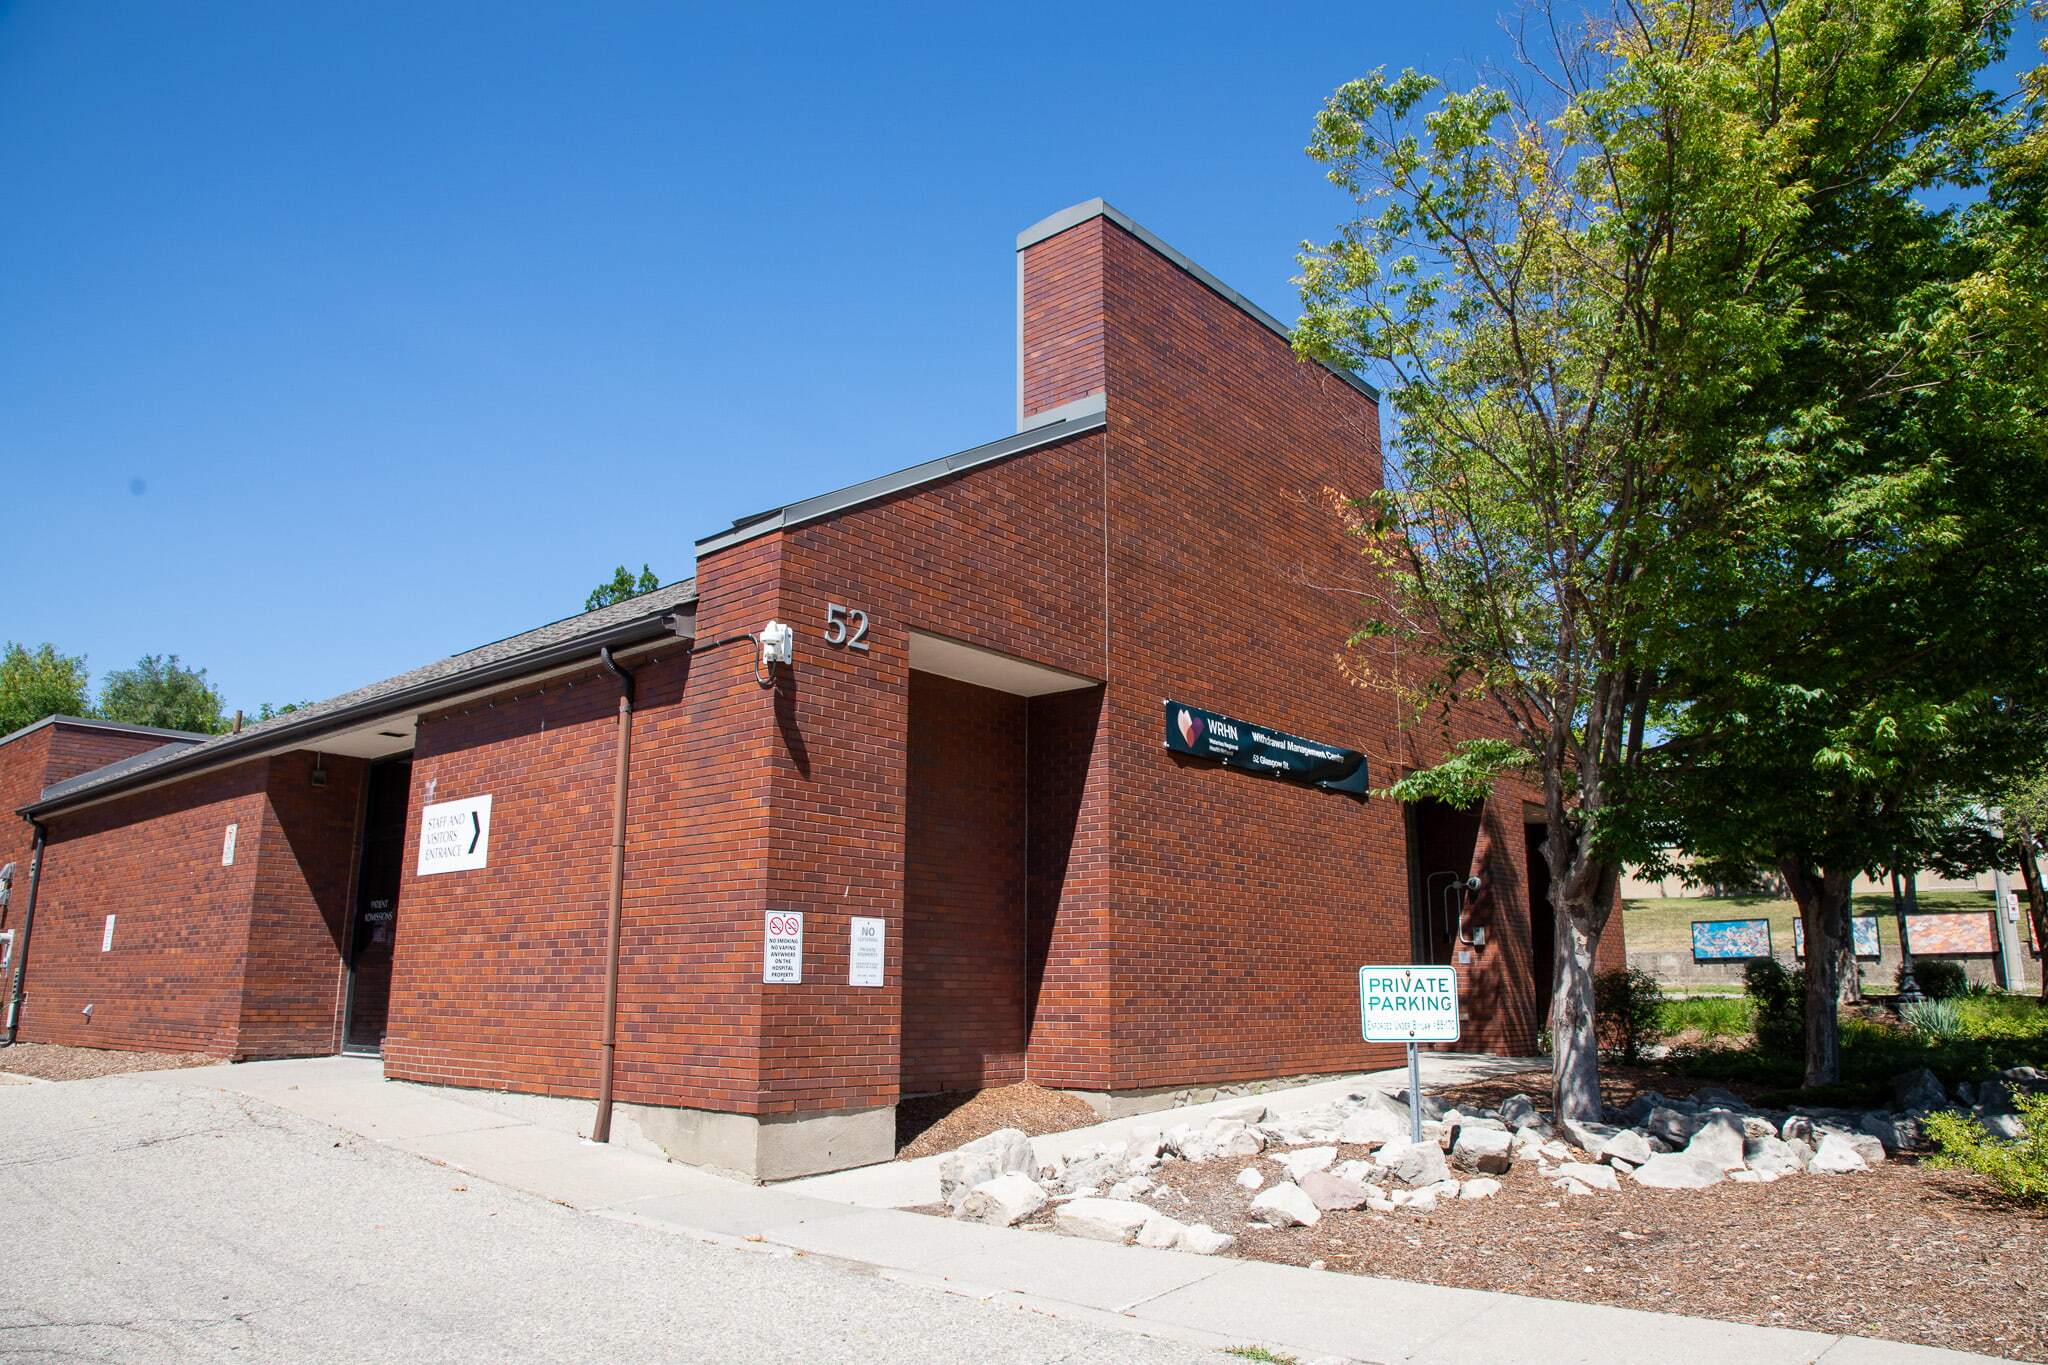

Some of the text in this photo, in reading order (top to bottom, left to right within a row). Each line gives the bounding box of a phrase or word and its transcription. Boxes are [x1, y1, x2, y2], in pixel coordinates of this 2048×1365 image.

[825, 603, 869, 651] 52
[1207, 718, 1239, 741] WRHN
[1251, 731, 1286, 750] Withdrawal
[1287, 740, 1327, 759] Management
[1252, 754, 1259, 764] 52
[1259, 755, 1283, 768] Glasgow
[428, 812, 465, 830] STAFF AND
[426, 830, 458, 845] VISITORS
[425, 845, 462, 860] ENTRANCE
[861, 927, 875, 936] NO
[1369, 977, 1449, 993] PRIVATE
[1367, 996, 1452, 1011] PARKING
